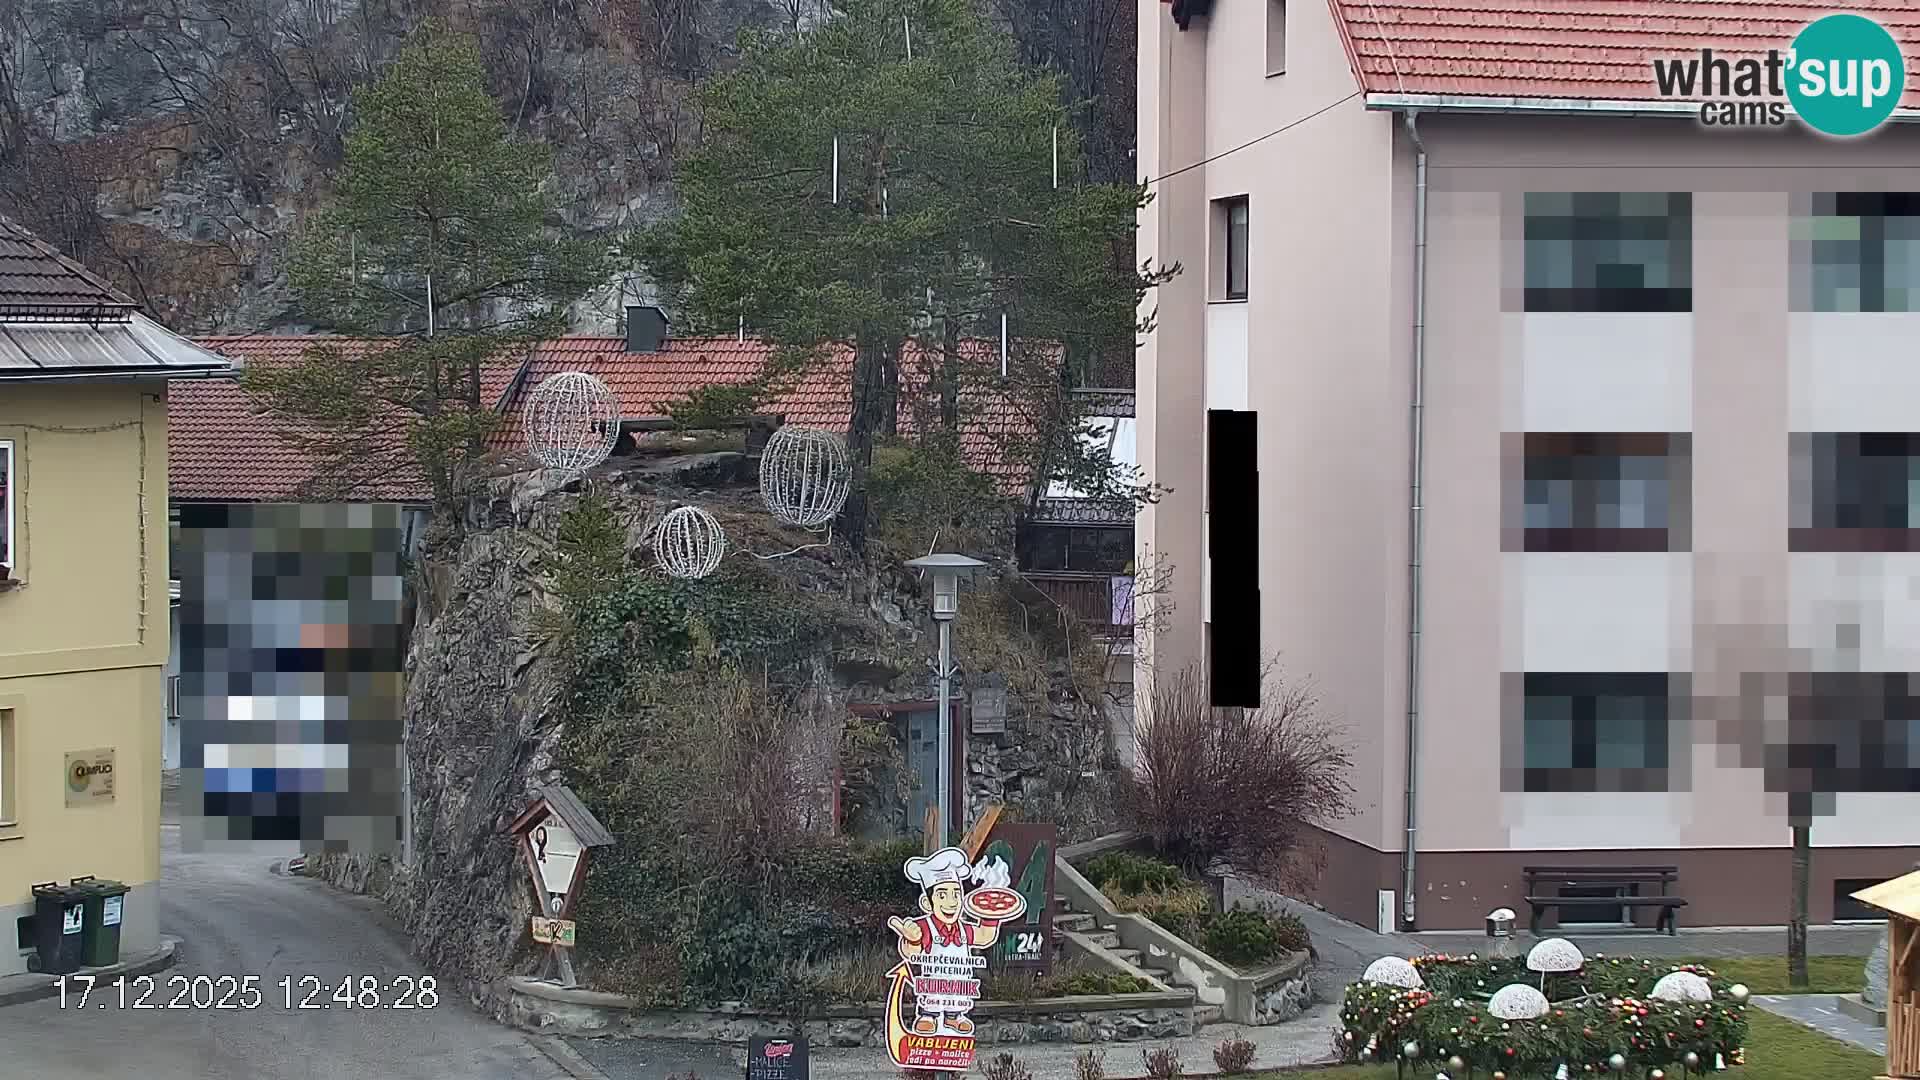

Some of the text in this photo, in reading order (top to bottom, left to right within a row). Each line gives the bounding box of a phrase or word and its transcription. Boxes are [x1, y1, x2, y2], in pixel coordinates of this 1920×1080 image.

[910, 954, 985, 966] OKREPČEVALNICA
[923, 965, 972, 975] IN PICERIJA
[908, 1036, 975, 1050] VABLJENI
[909, 1048, 970, 1057] pizze malice
[906, 1056, 922, 1065] jedi
